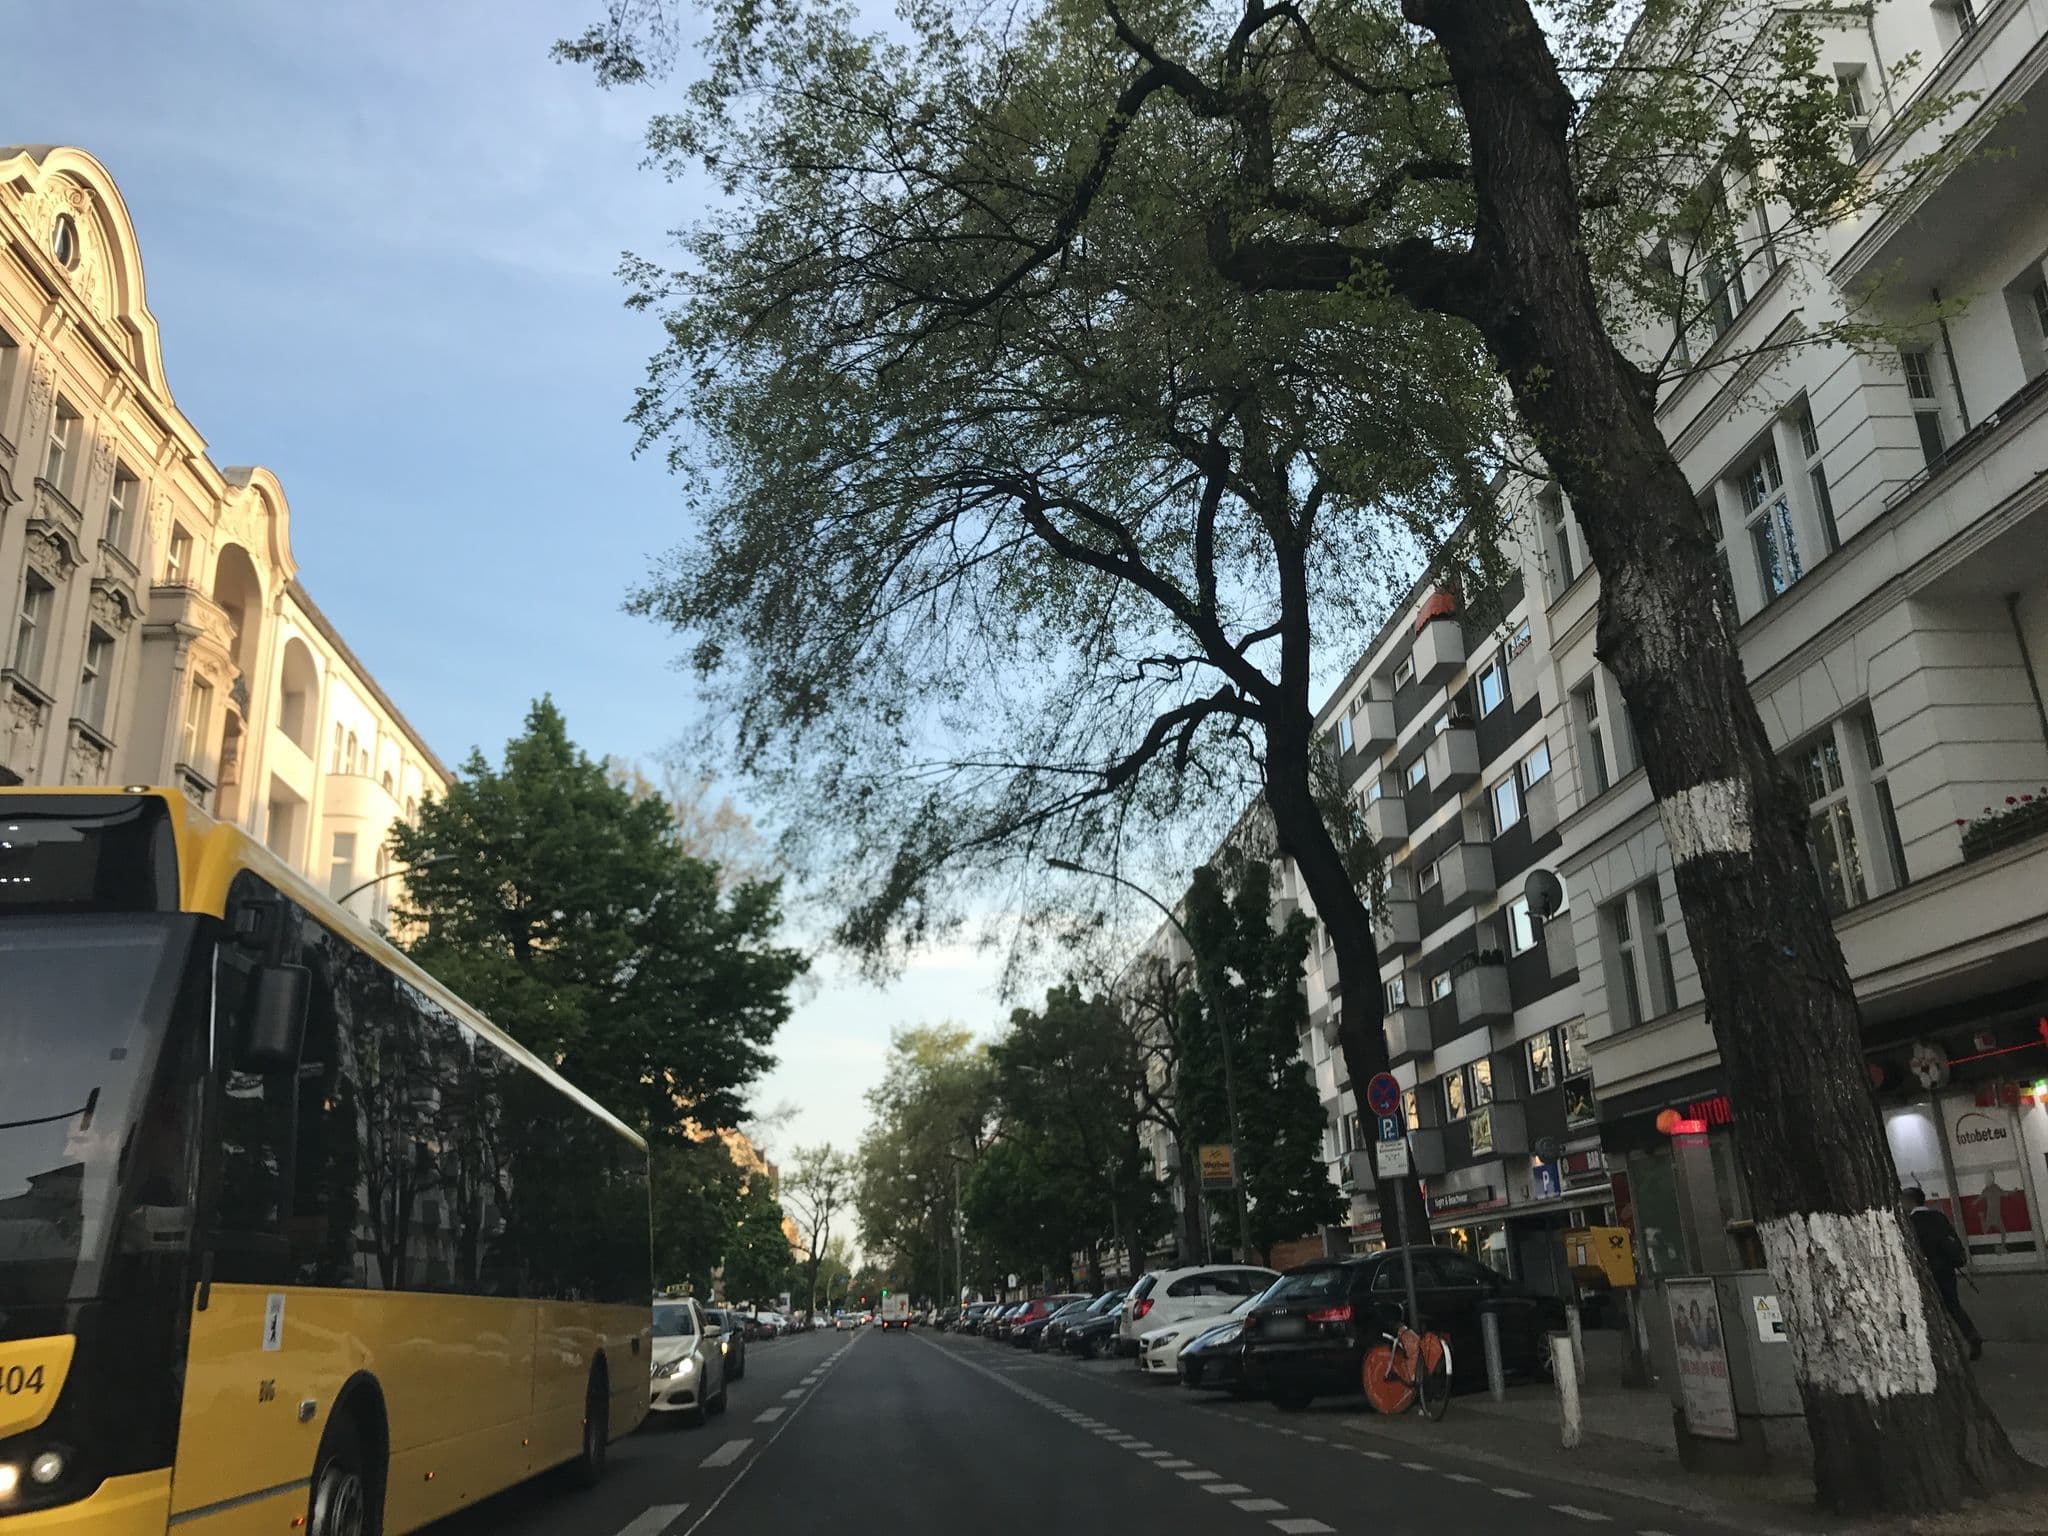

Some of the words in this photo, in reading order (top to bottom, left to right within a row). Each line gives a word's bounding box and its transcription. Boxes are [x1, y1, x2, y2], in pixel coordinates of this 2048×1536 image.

[1383, 1118, 1393, 1139] P
[1542, 1170, 1550, 1191] P
[0, 1366, 45, 1395] 04
